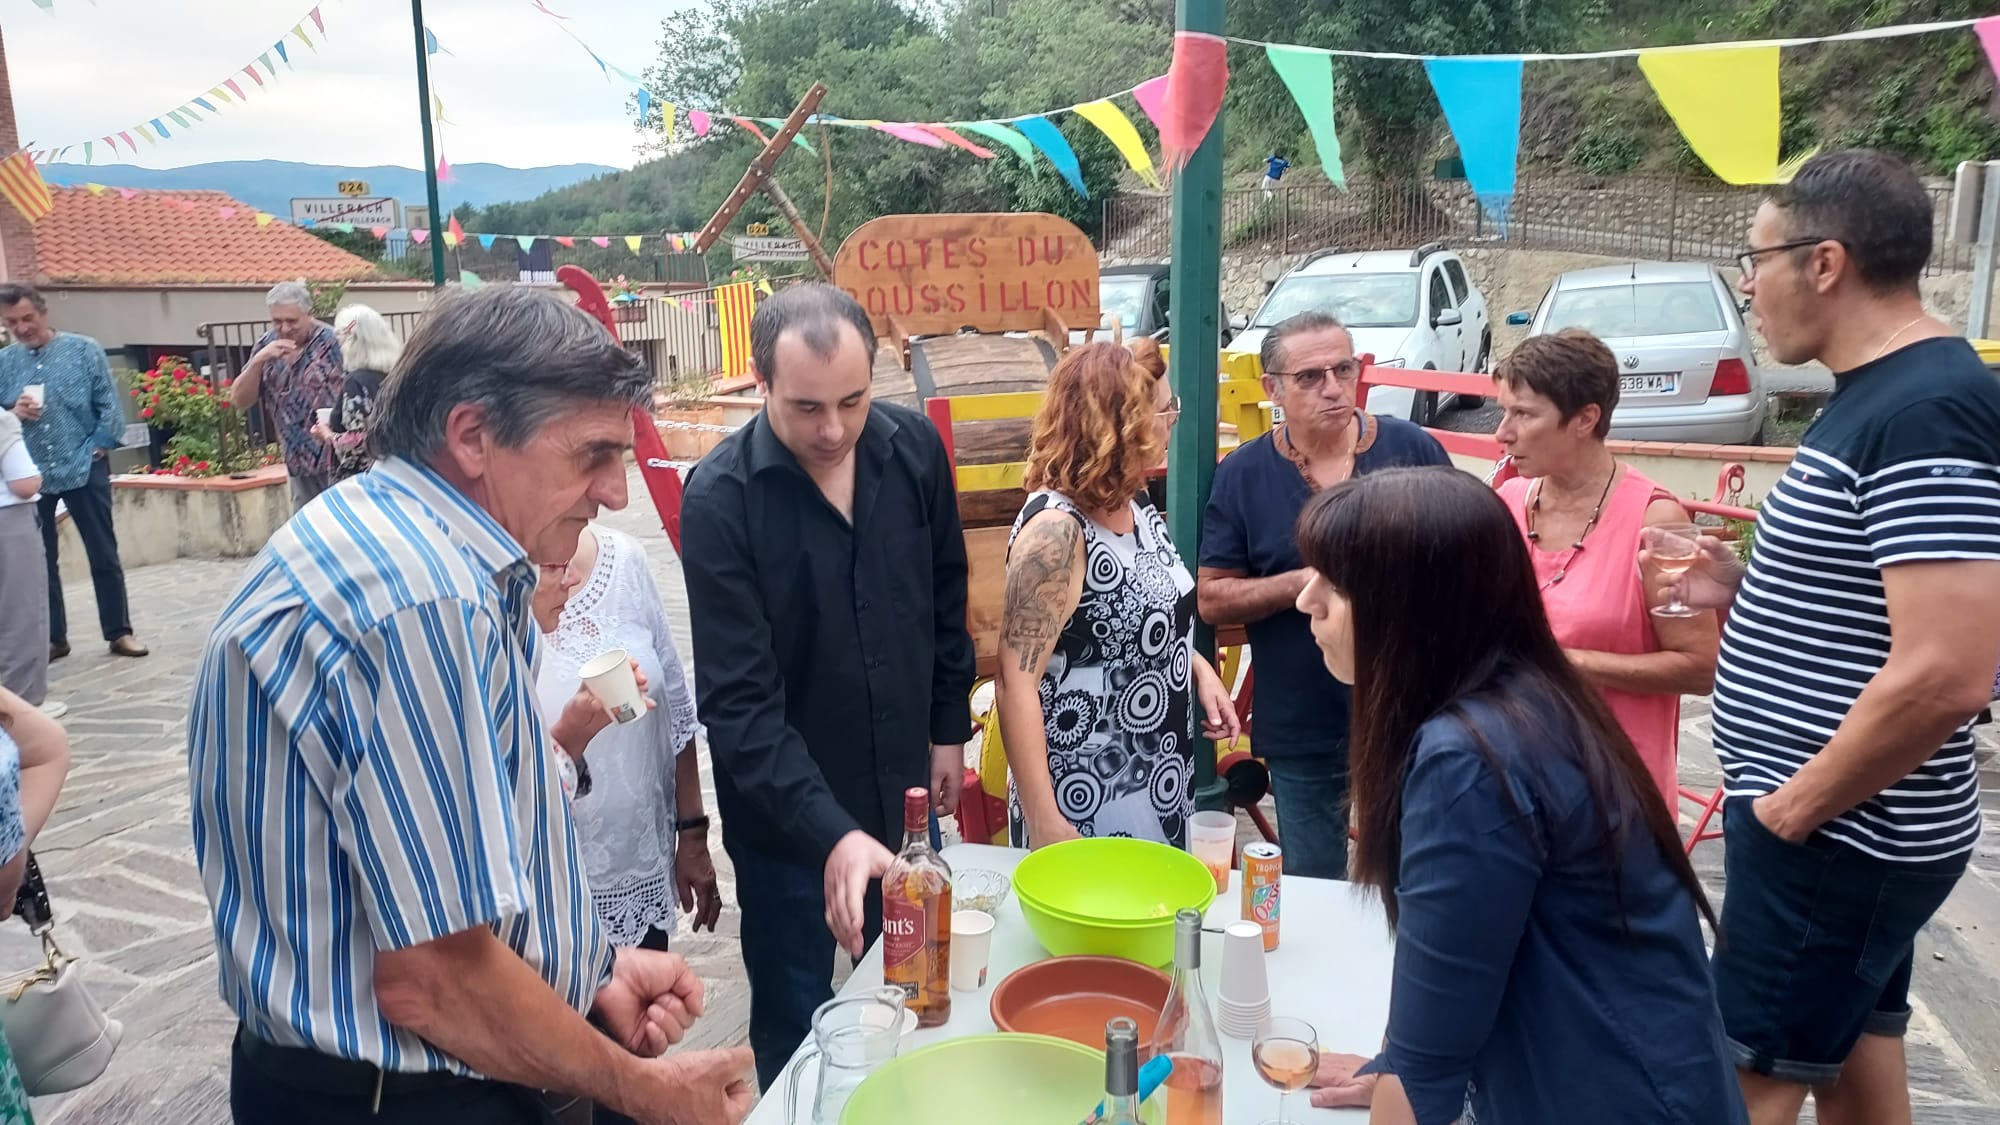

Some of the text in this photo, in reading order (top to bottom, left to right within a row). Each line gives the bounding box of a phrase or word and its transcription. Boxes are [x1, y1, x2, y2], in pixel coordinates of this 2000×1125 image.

[304, 203, 383, 214] VILLERACH
[859, 235, 1064, 272] COTES DU
